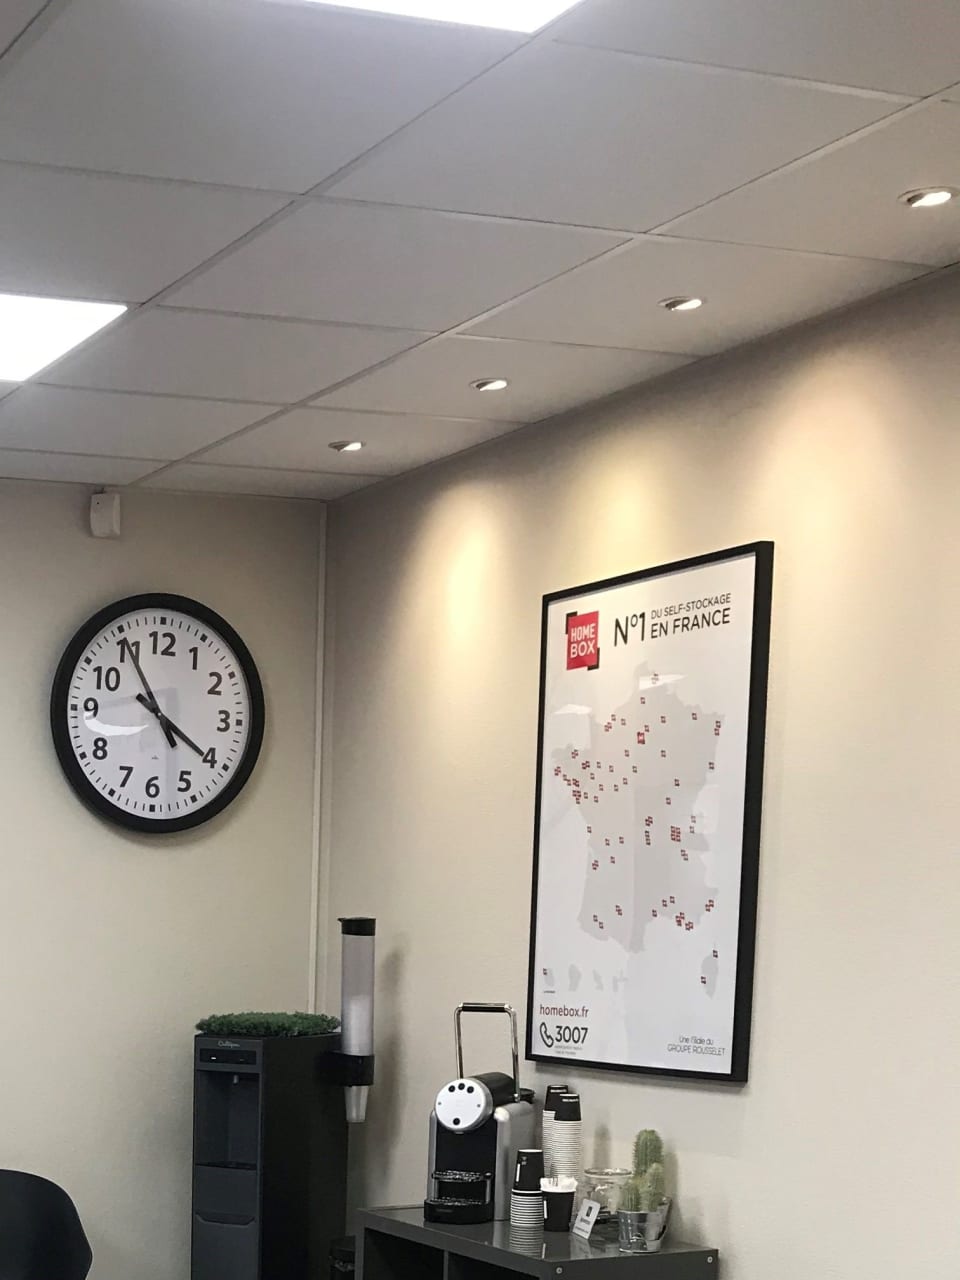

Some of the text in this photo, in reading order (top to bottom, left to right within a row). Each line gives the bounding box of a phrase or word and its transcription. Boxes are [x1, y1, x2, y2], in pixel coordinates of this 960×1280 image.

[651, 593, 731, 620] DU SELF-STOCKAGE
[570, 623, 595, 642] HOME
[650, 608, 731, 639] EN FRANCE
[116, 638, 141, 664] 11
[148, 630, 177, 657] 12
[570, 641, 595, 659] BOX
[188, 646, 200, 670] 1
[93, 665, 121, 692] 10
[207, 671, 222, 696] 2
[83, 697, 99, 718] 9
[216, 710, 231, 733] 3
[92, 737, 108, 760] 8
[202, 747, 218, 769] 4
[119, 765, 134, 788] 7
[145, 775, 160, 798] 6
[177, 770, 192, 793] 5
[540, 1004, 589, 1018] homebox.fr
[555, 1025, 588, 1044] 3007
